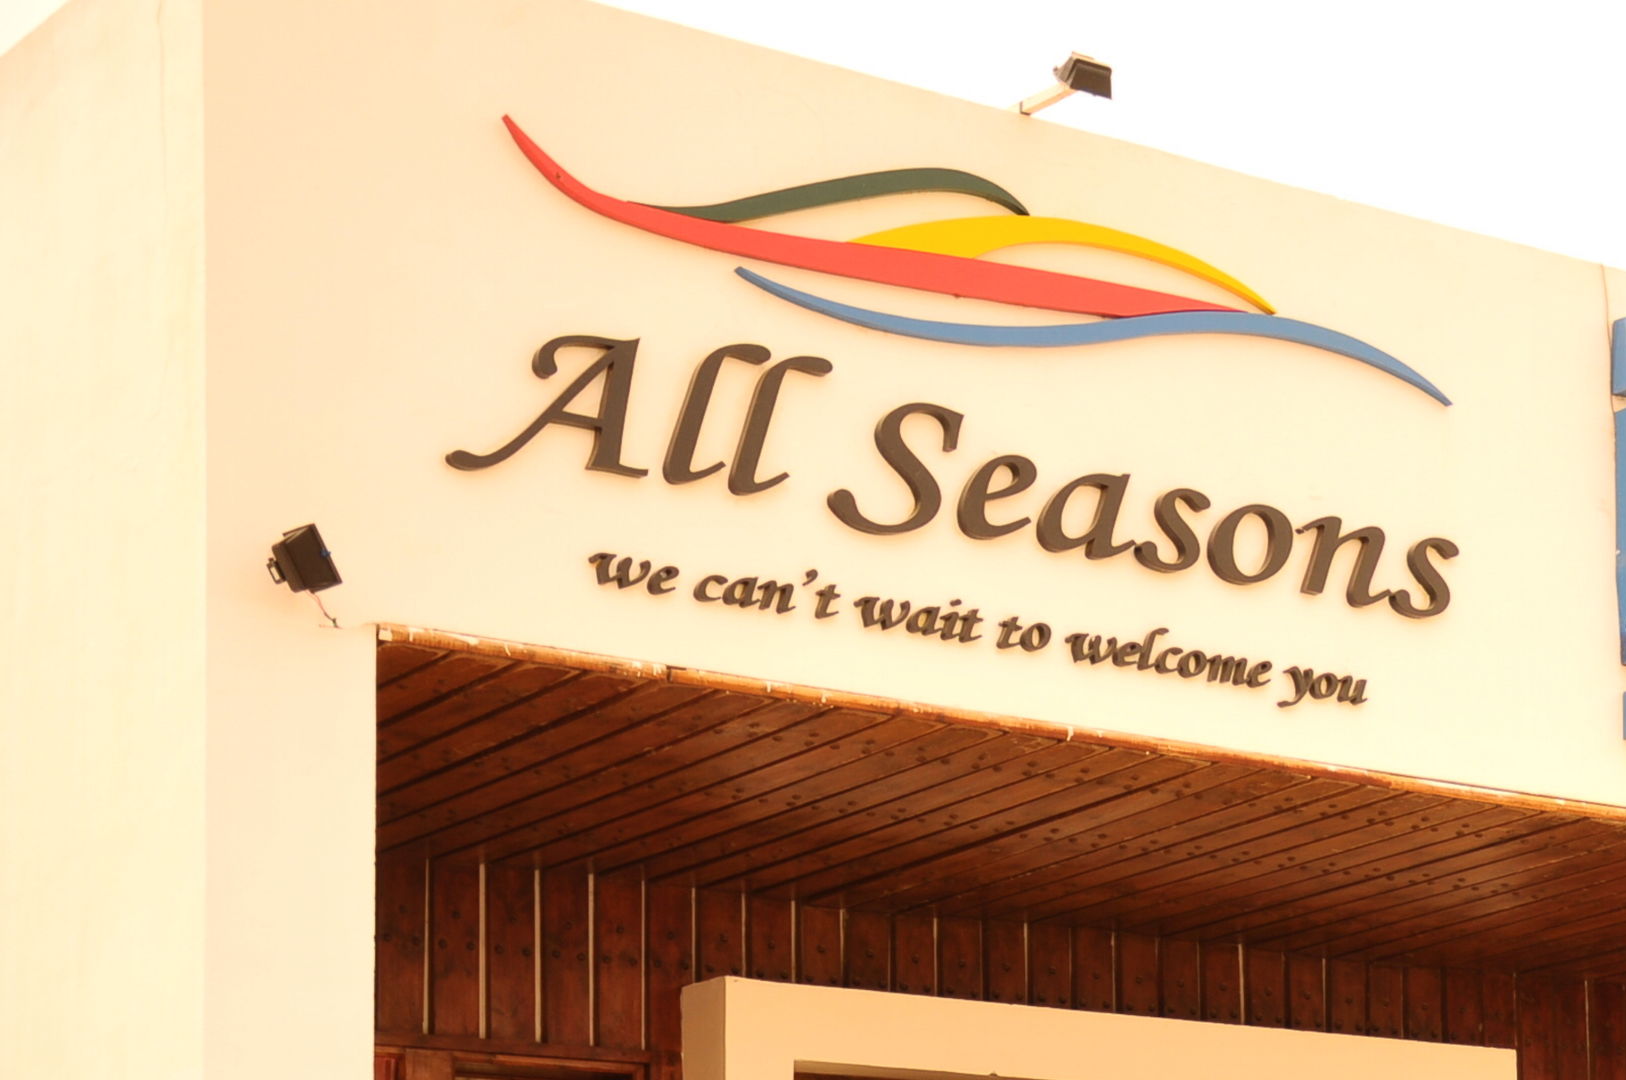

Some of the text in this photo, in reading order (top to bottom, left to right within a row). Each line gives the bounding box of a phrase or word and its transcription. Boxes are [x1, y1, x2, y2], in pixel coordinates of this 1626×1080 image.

[444, 334, 1460, 619] All Seasons
[588, 552, 1368, 708] we can't wait to welcome you
